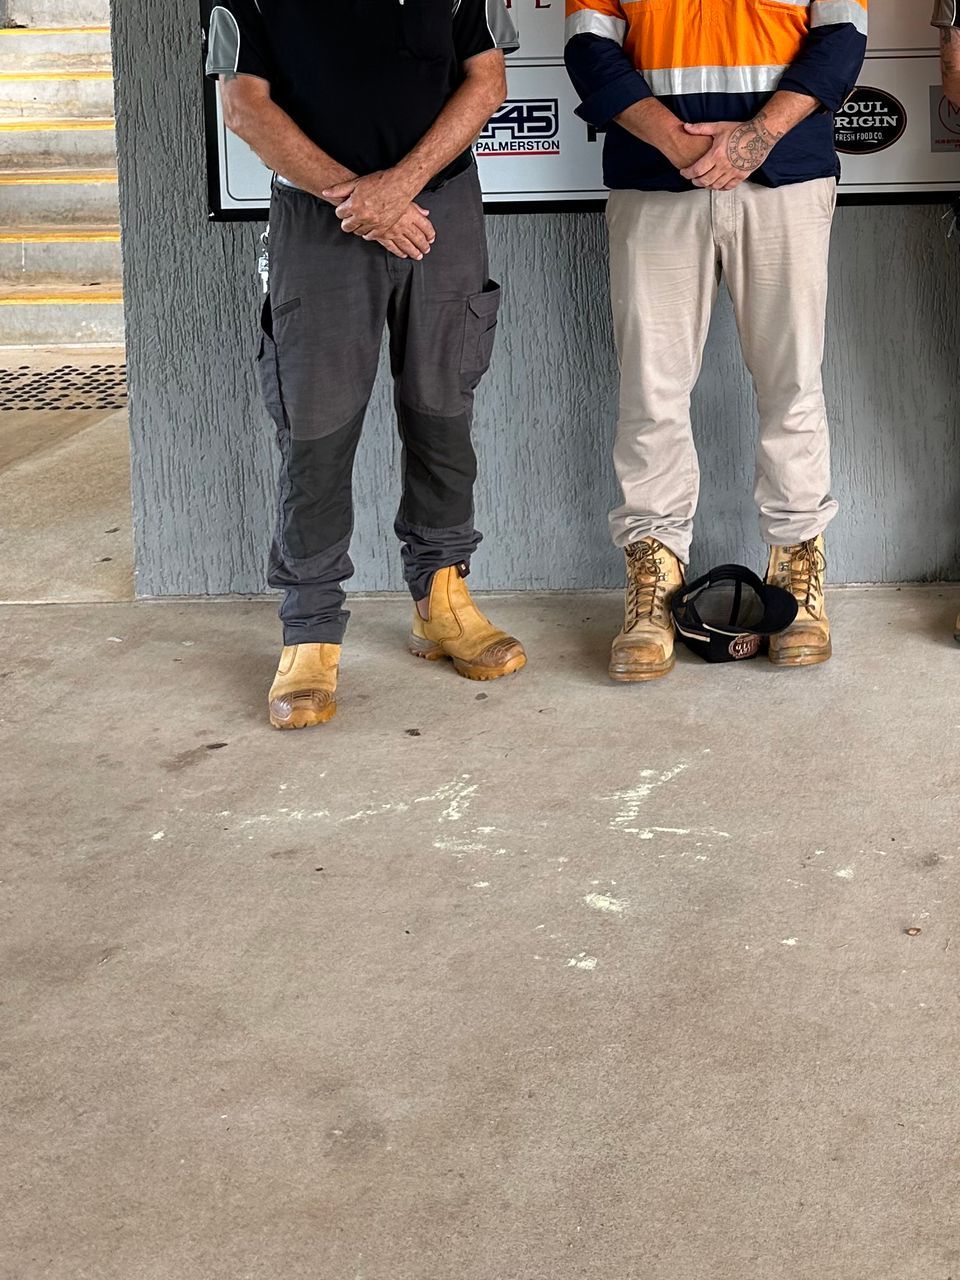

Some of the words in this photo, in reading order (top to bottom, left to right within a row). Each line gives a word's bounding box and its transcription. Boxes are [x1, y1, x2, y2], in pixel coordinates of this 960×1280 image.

[833, 115, 898, 128] RIGIN
[835, 133, 856, 142] FRESH
[856, 131, 874, 141] FOOD
[475, 140, 560, 152] PALMERSTON
